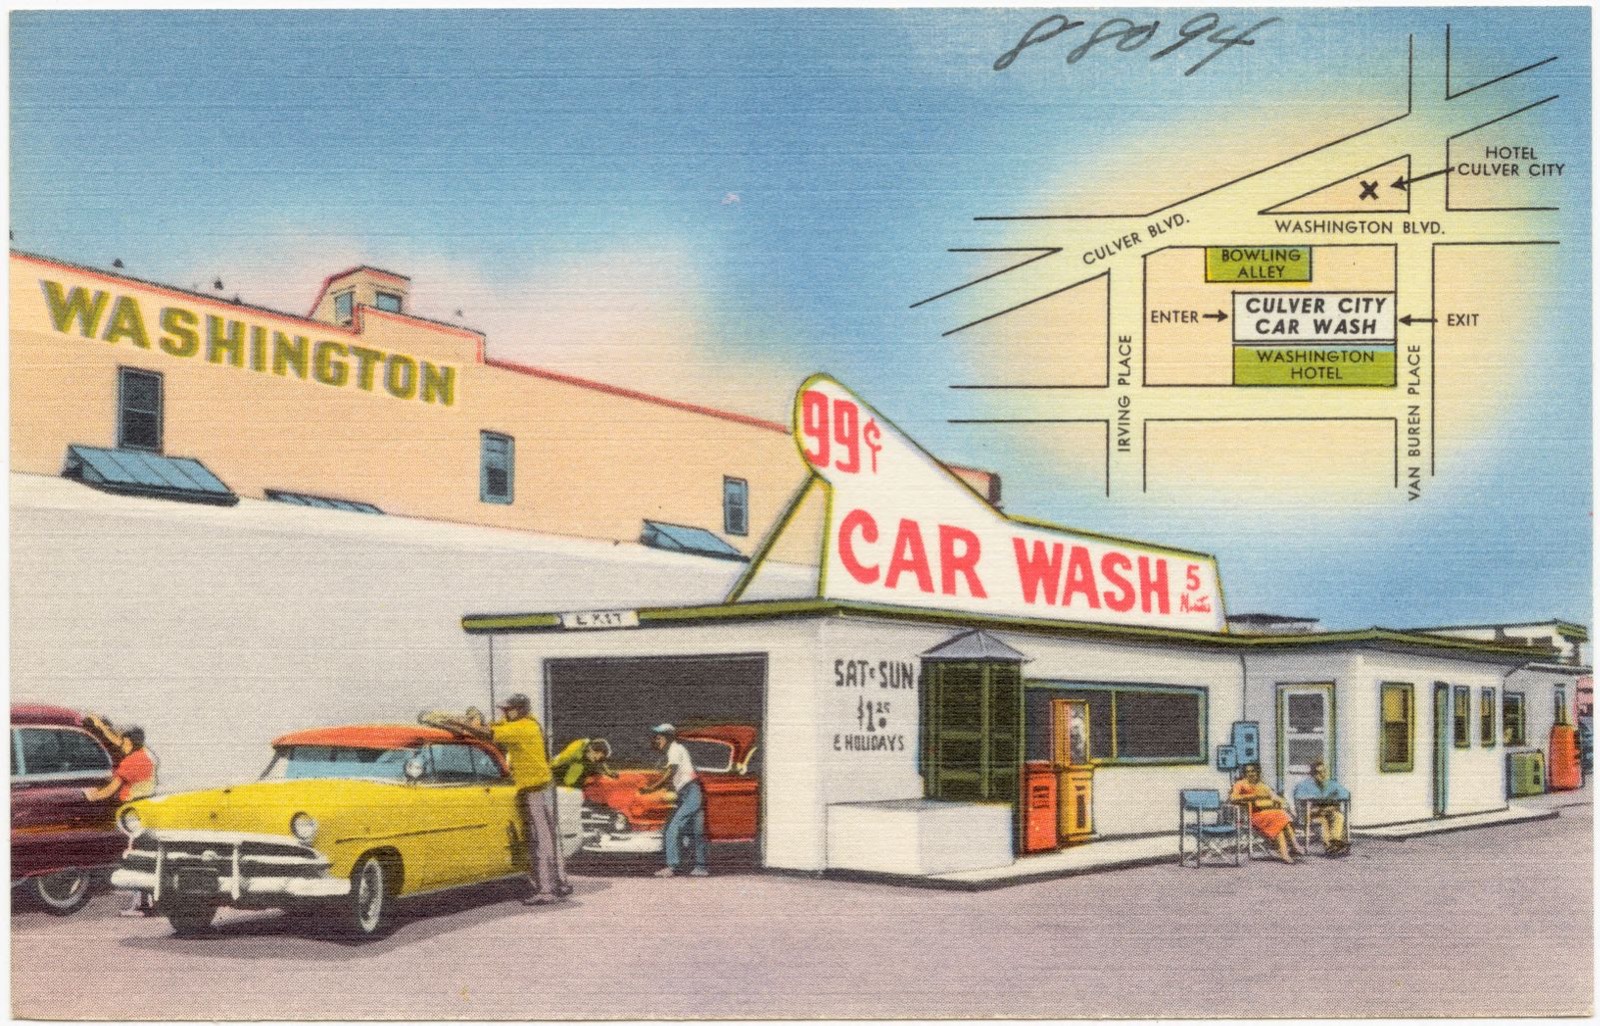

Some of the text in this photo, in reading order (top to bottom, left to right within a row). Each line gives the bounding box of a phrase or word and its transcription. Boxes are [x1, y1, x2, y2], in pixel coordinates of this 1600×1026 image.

[1485, 146, 1538, 160] HOTEL
[1457, 163, 1565, 177] CULVER CITY
[1274, 219, 1446, 235] WASHINGTON BLVD.
[1082, 213, 1191, 266] CULVER BLVD.
[1221, 248, 1301, 263] BOWLING
[1237, 265, 1286, 279] ALLEY
[1245, 297, 1387, 314] CULVER CITY
[1150, 310, 1199, 324] ENTER
[1447, 313, 1479, 327] EXIT
[1254, 318, 1377, 335] CAR WASH
[40, 277, 458, 407] WASHINGTON
[1256, 350, 1375, 363] WASHINGTON
[1290, 366, 1343, 380] HOTEL
[1117, 335, 1132, 453] IRVING PLACE
[1407, 344, 1421, 502] VAN BUREN PLACE
[837, 508, 1171, 616] CAR WASH
[1186, 564, 1201, 591] 5
[845, 733, 905, 752] HOLIDAYS
